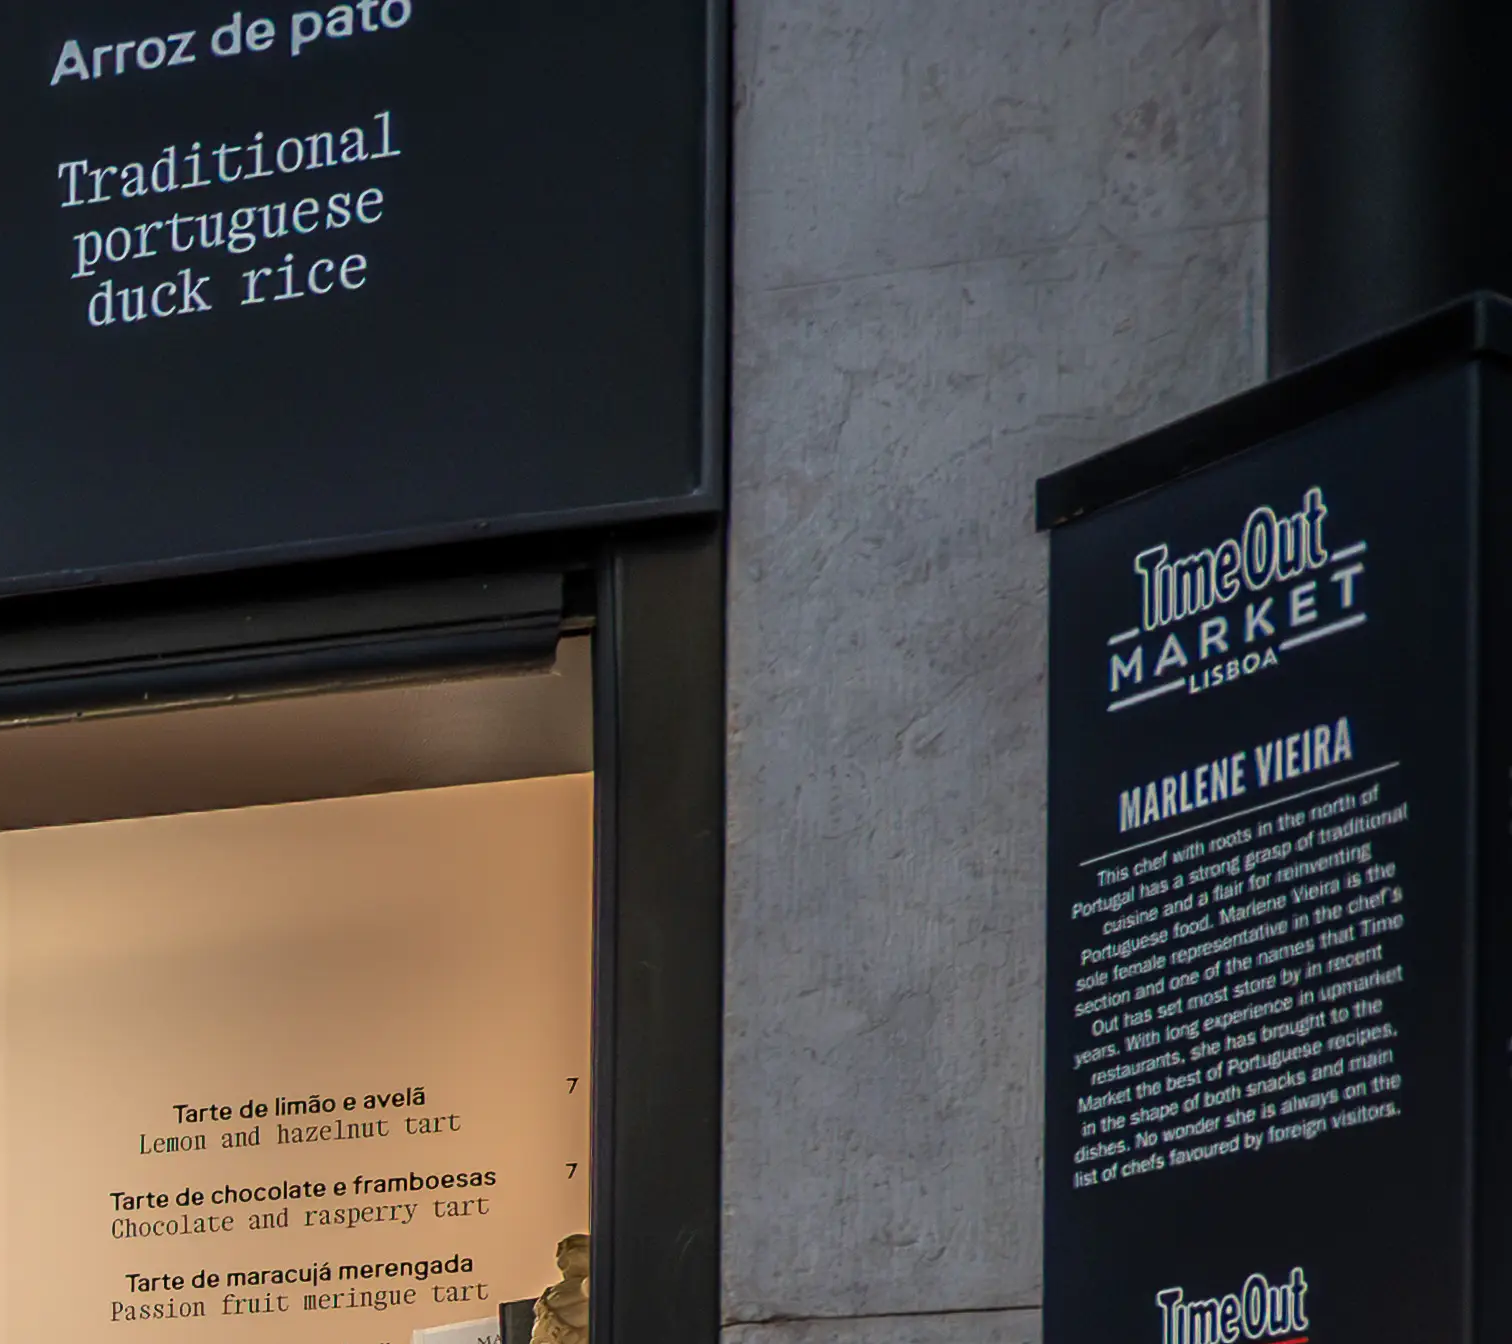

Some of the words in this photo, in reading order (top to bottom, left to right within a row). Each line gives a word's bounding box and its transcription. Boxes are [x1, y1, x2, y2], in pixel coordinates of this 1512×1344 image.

[50, 31, 196, 86] Arroz
[211, 11, 275, 56] de
[291, 0, 411, 56] pato
[58, 111, 401, 207] Traditional
[71, 188, 383, 278] portuguese
[89, 268, 212, 326] duck
[241, 253, 367, 305] rice
[1109, 562, 1364, 692] MARKET
[1189, 646, 1279, 694] LISBOA
[1119, 751, 1246, 833] MARLENE
[1254, 716, 1352, 788] VIEIRA
[173, 1104, 232, 1124] Tarte
[240, 1100, 268, 1118] de
[275, 1095, 336, 1116] limão
[343, 1097, 356, 1111] e
[364, 1087, 425, 1109] avelã
[566, 1077, 579, 1094] 7
[110, 1192, 169, 1211] Tarte
[176, 1187, 204, 1206] de
[211, 1180, 326, 1204] chocolate
[333, 1182, 346, 1196] e
[353, 1171, 496, 1194] framboesas
[566, 1163, 578, 1179] 7
